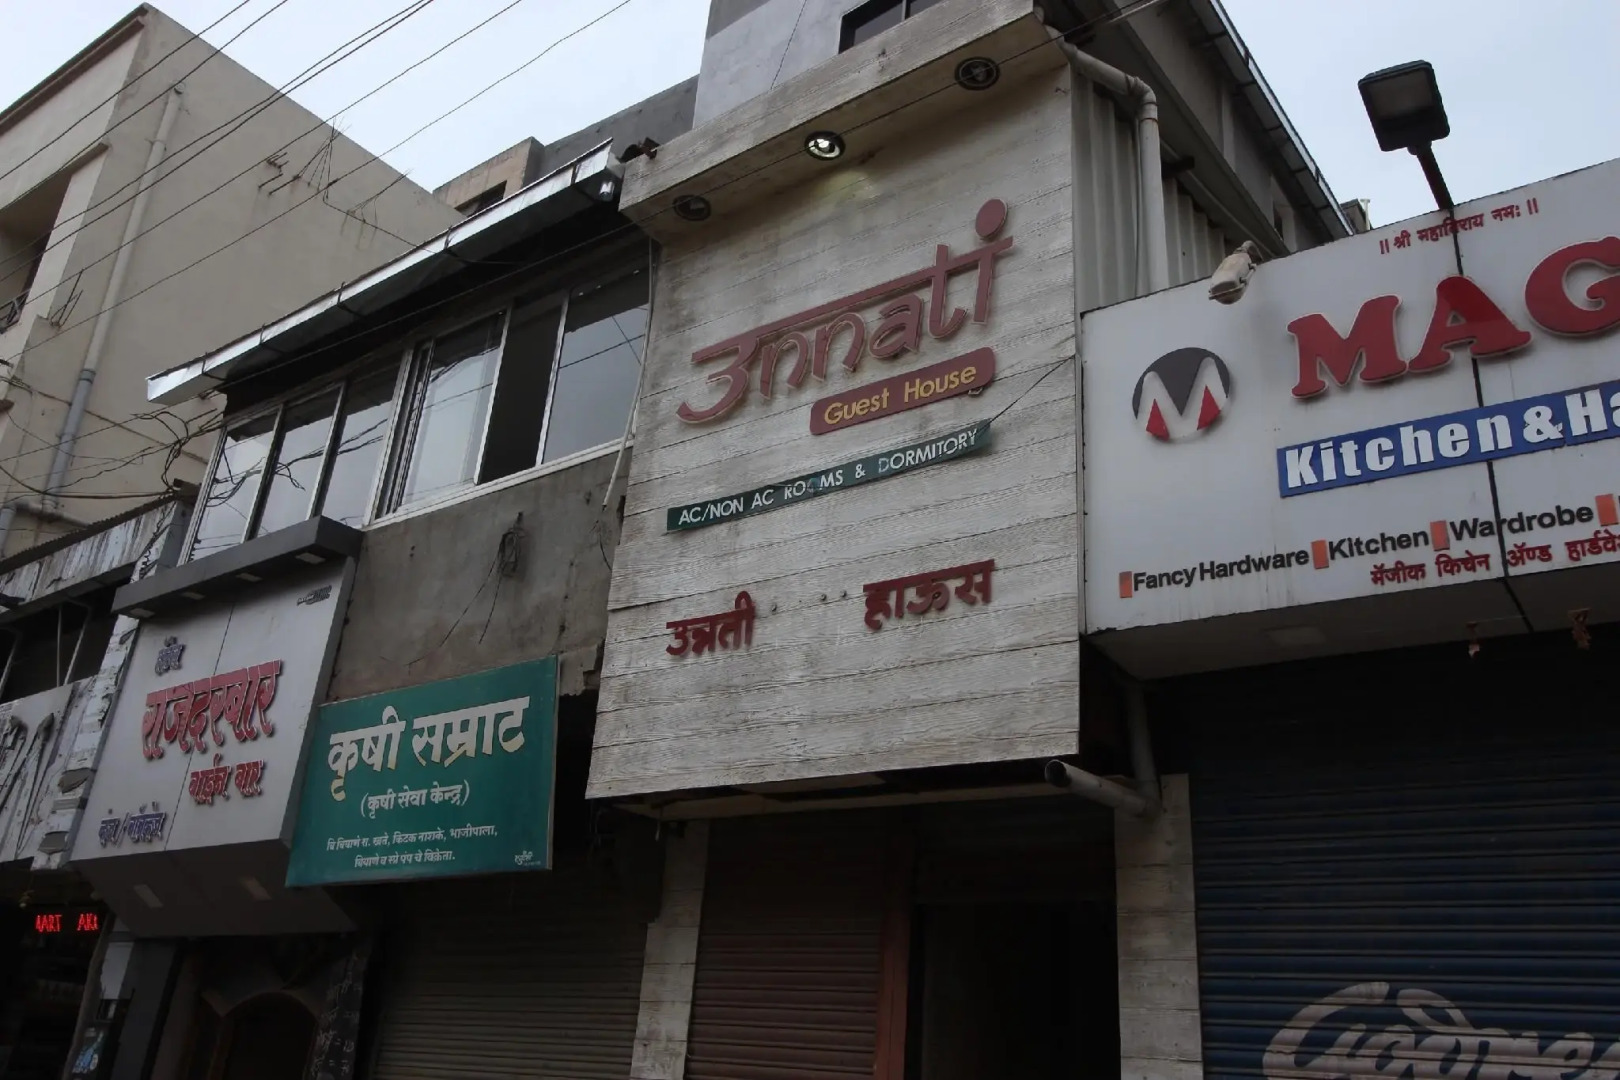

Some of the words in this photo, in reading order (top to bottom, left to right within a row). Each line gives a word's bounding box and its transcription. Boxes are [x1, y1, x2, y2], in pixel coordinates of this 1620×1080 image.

[823, 389, 890, 425] Guest
[903, 365, 977, 401] House
[678, 496, 744, 526] AC/NON
[750, 489, 774, 512] AC
[855, 463, 866, 479] &
[878, 428, 978, 474] DORMITORY
[1284, 412, 1512, 489] Kitchen
[1523, 405, 1564, 444] &
[1328, 530, 1430, 561] Kitchen
[1450, 504, 1594, 541] Wardrobe
[1133, 566, 1197, 592] Fancy
[1199, 548, 1310, 581] Hardware
[1435, 550, 1491, 578] किचेन
[1565, 528, 1620, 562] हार्डवे
[665, 590, 756, 656] उन्नती
[862, 558, 995, 630] हाऊस
[142, 658, 283, 760] राजदरबार
[327, 705, 406, 802] कृषी
[412, 695, 531, 768] सम्राट
[398, 784, 429, 809] सेवा
